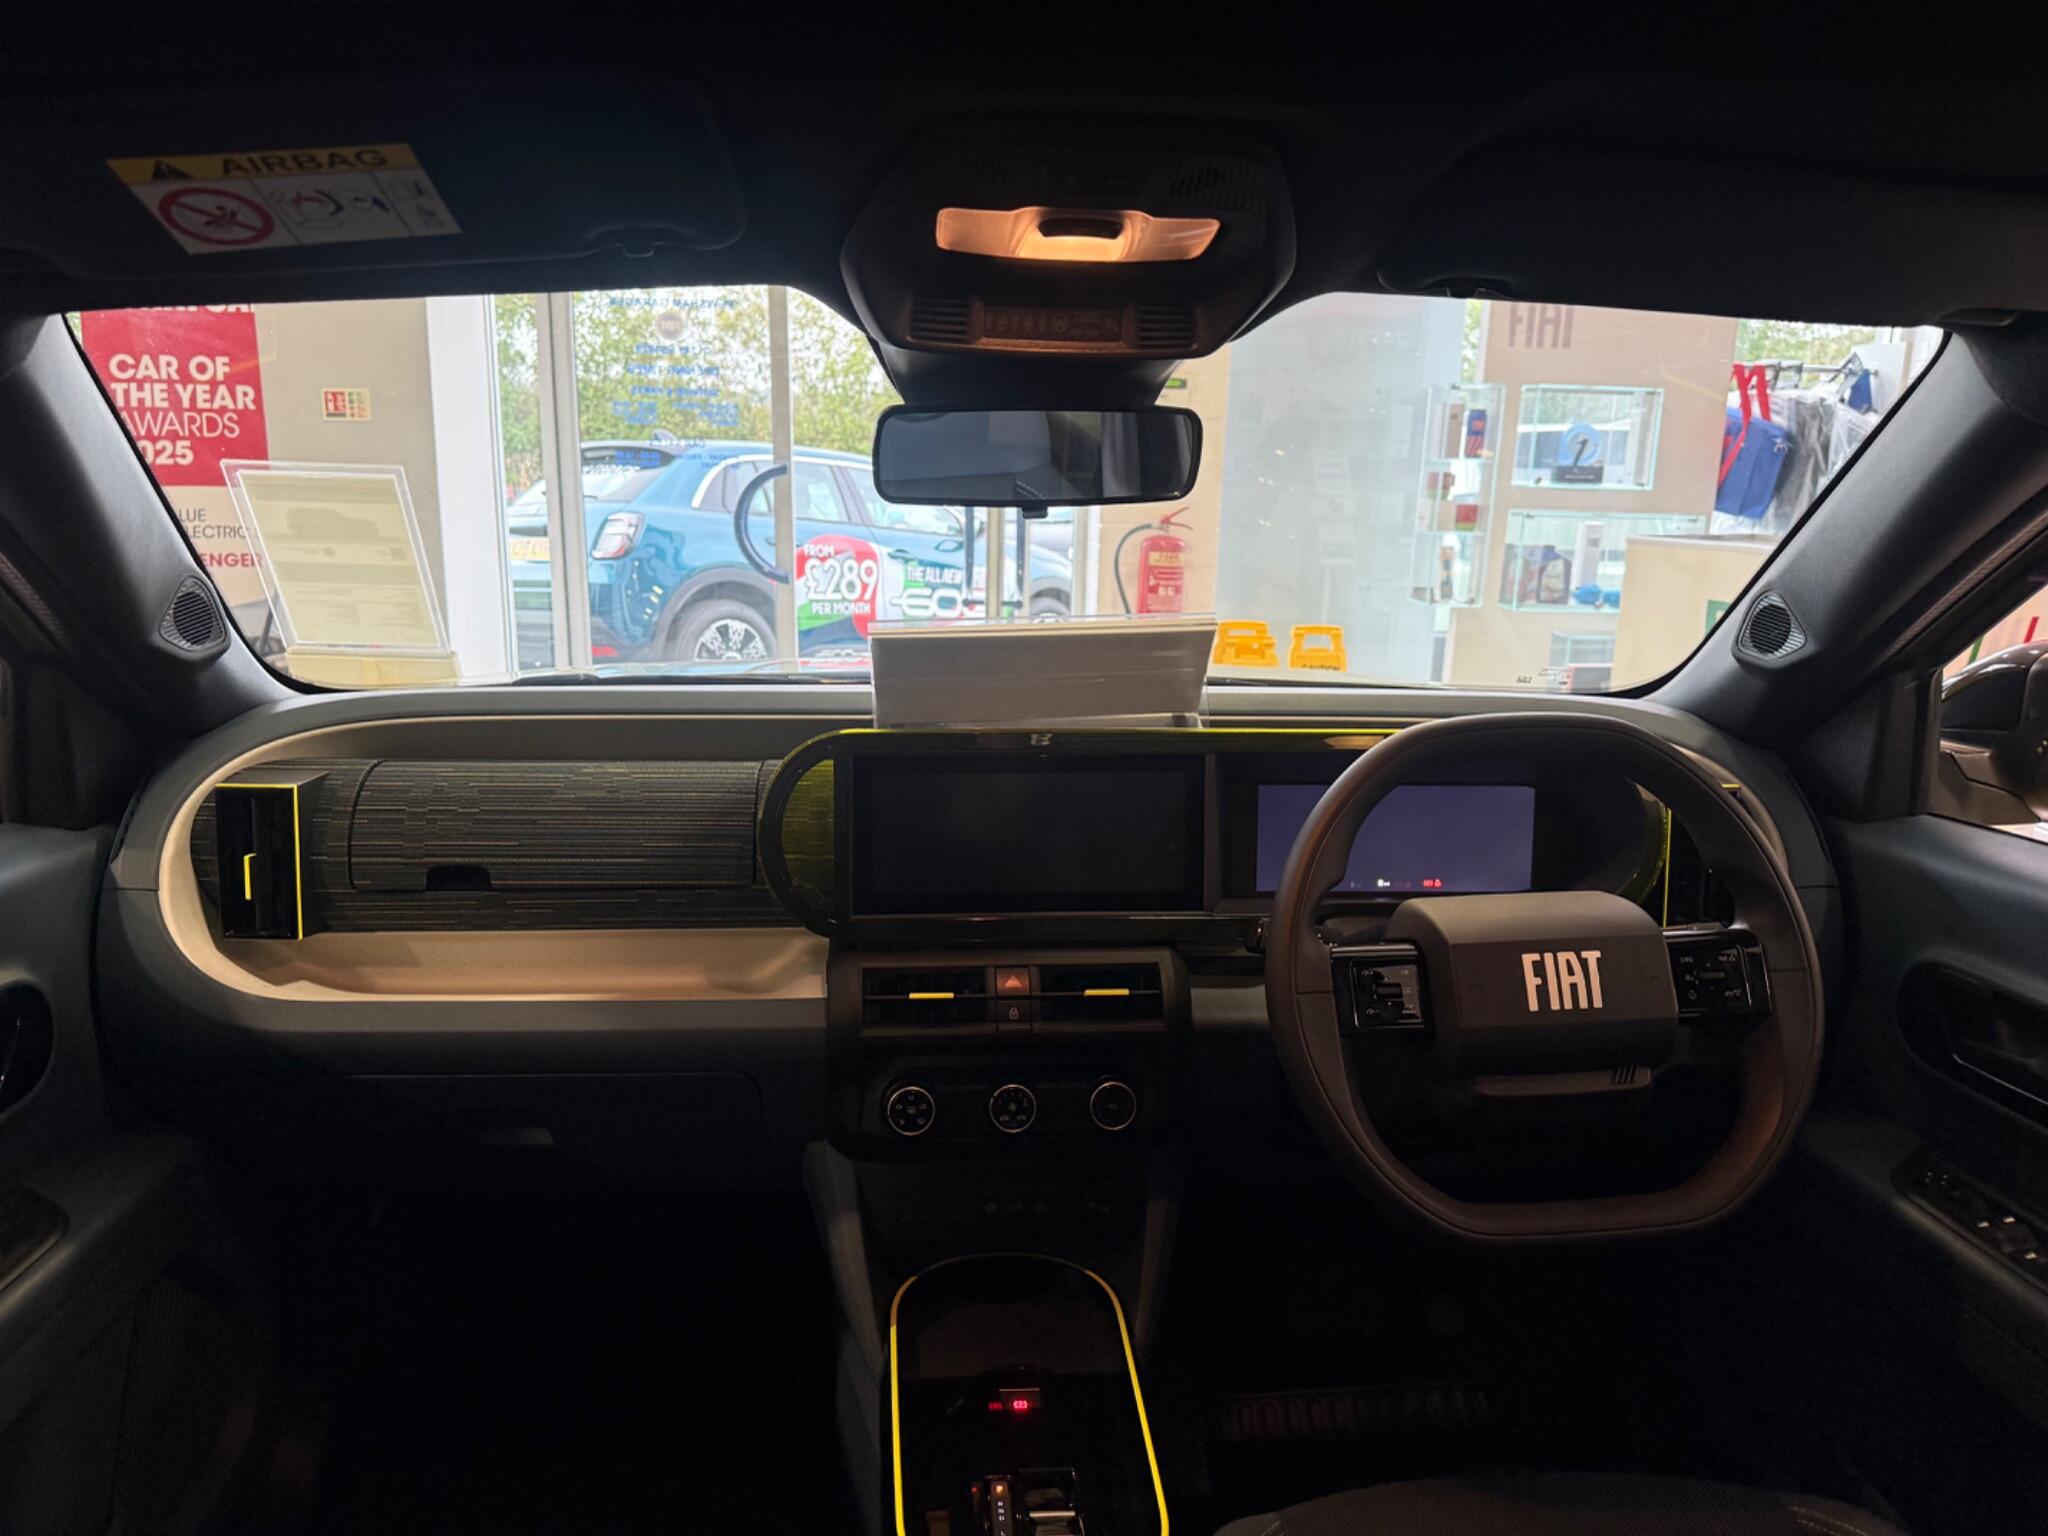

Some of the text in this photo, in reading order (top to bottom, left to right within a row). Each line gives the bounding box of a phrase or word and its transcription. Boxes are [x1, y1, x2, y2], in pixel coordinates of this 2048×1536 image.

[221, 150, 388, 177] AIRBAG
[109, 353, 230, 381] CAR OF
[110, 382, 257, 410] THE YEAR
[121, 411, 240, 438] AWARDS
[137, 440, 194, 465] 025
[178, 508, 206, 522] LUE
[186, 525, 249, 539] LECTRIC
[199, 553, 263, 568] ENGER
[804, 544, 835, 557] FROM
[804, 558, 879, 601] £289
[811, 601, 871, 615] PER MONTH
[1520, 950, 1603, 1012] FIAT
